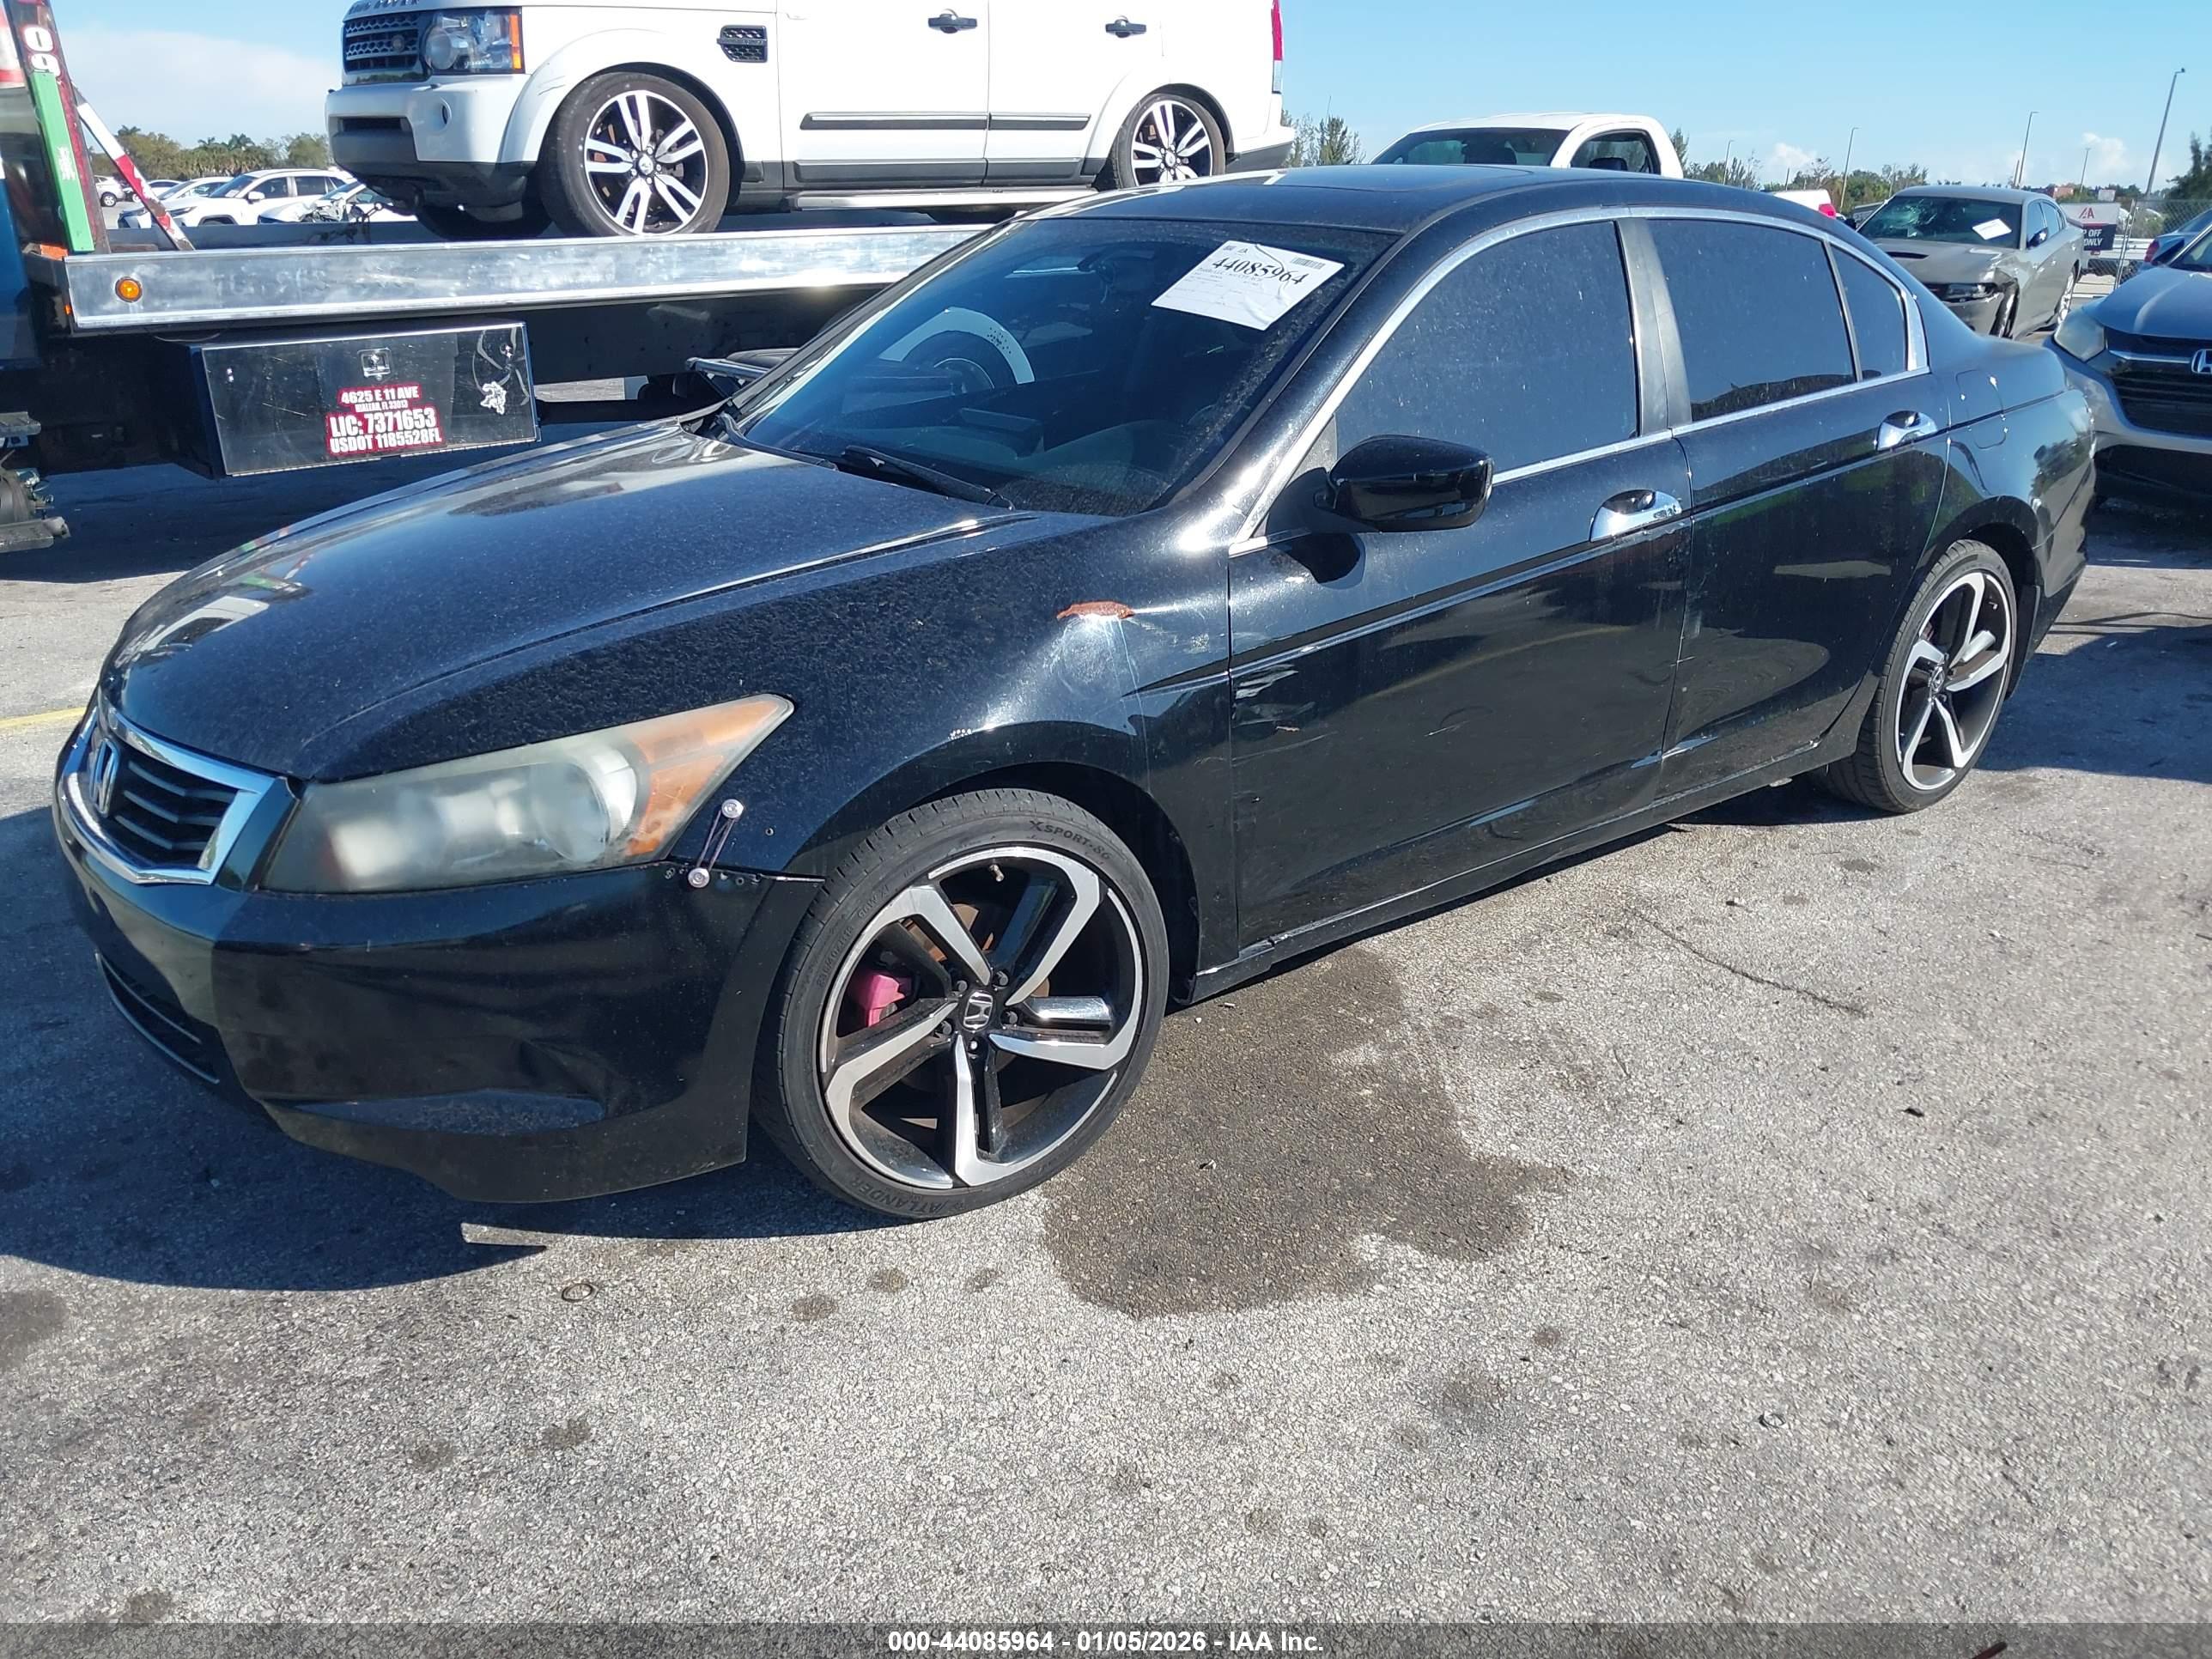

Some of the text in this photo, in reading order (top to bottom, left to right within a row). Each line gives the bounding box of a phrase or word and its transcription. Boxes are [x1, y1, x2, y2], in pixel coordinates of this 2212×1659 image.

[1212, 258, 1309, 285] 44085964
[341, 386, 420, 404] 4625 E 11 AVE
[330, 407, 436, 437] LIC: 7371653
[330, 428, 442, 453] USDOT 1185528FL
